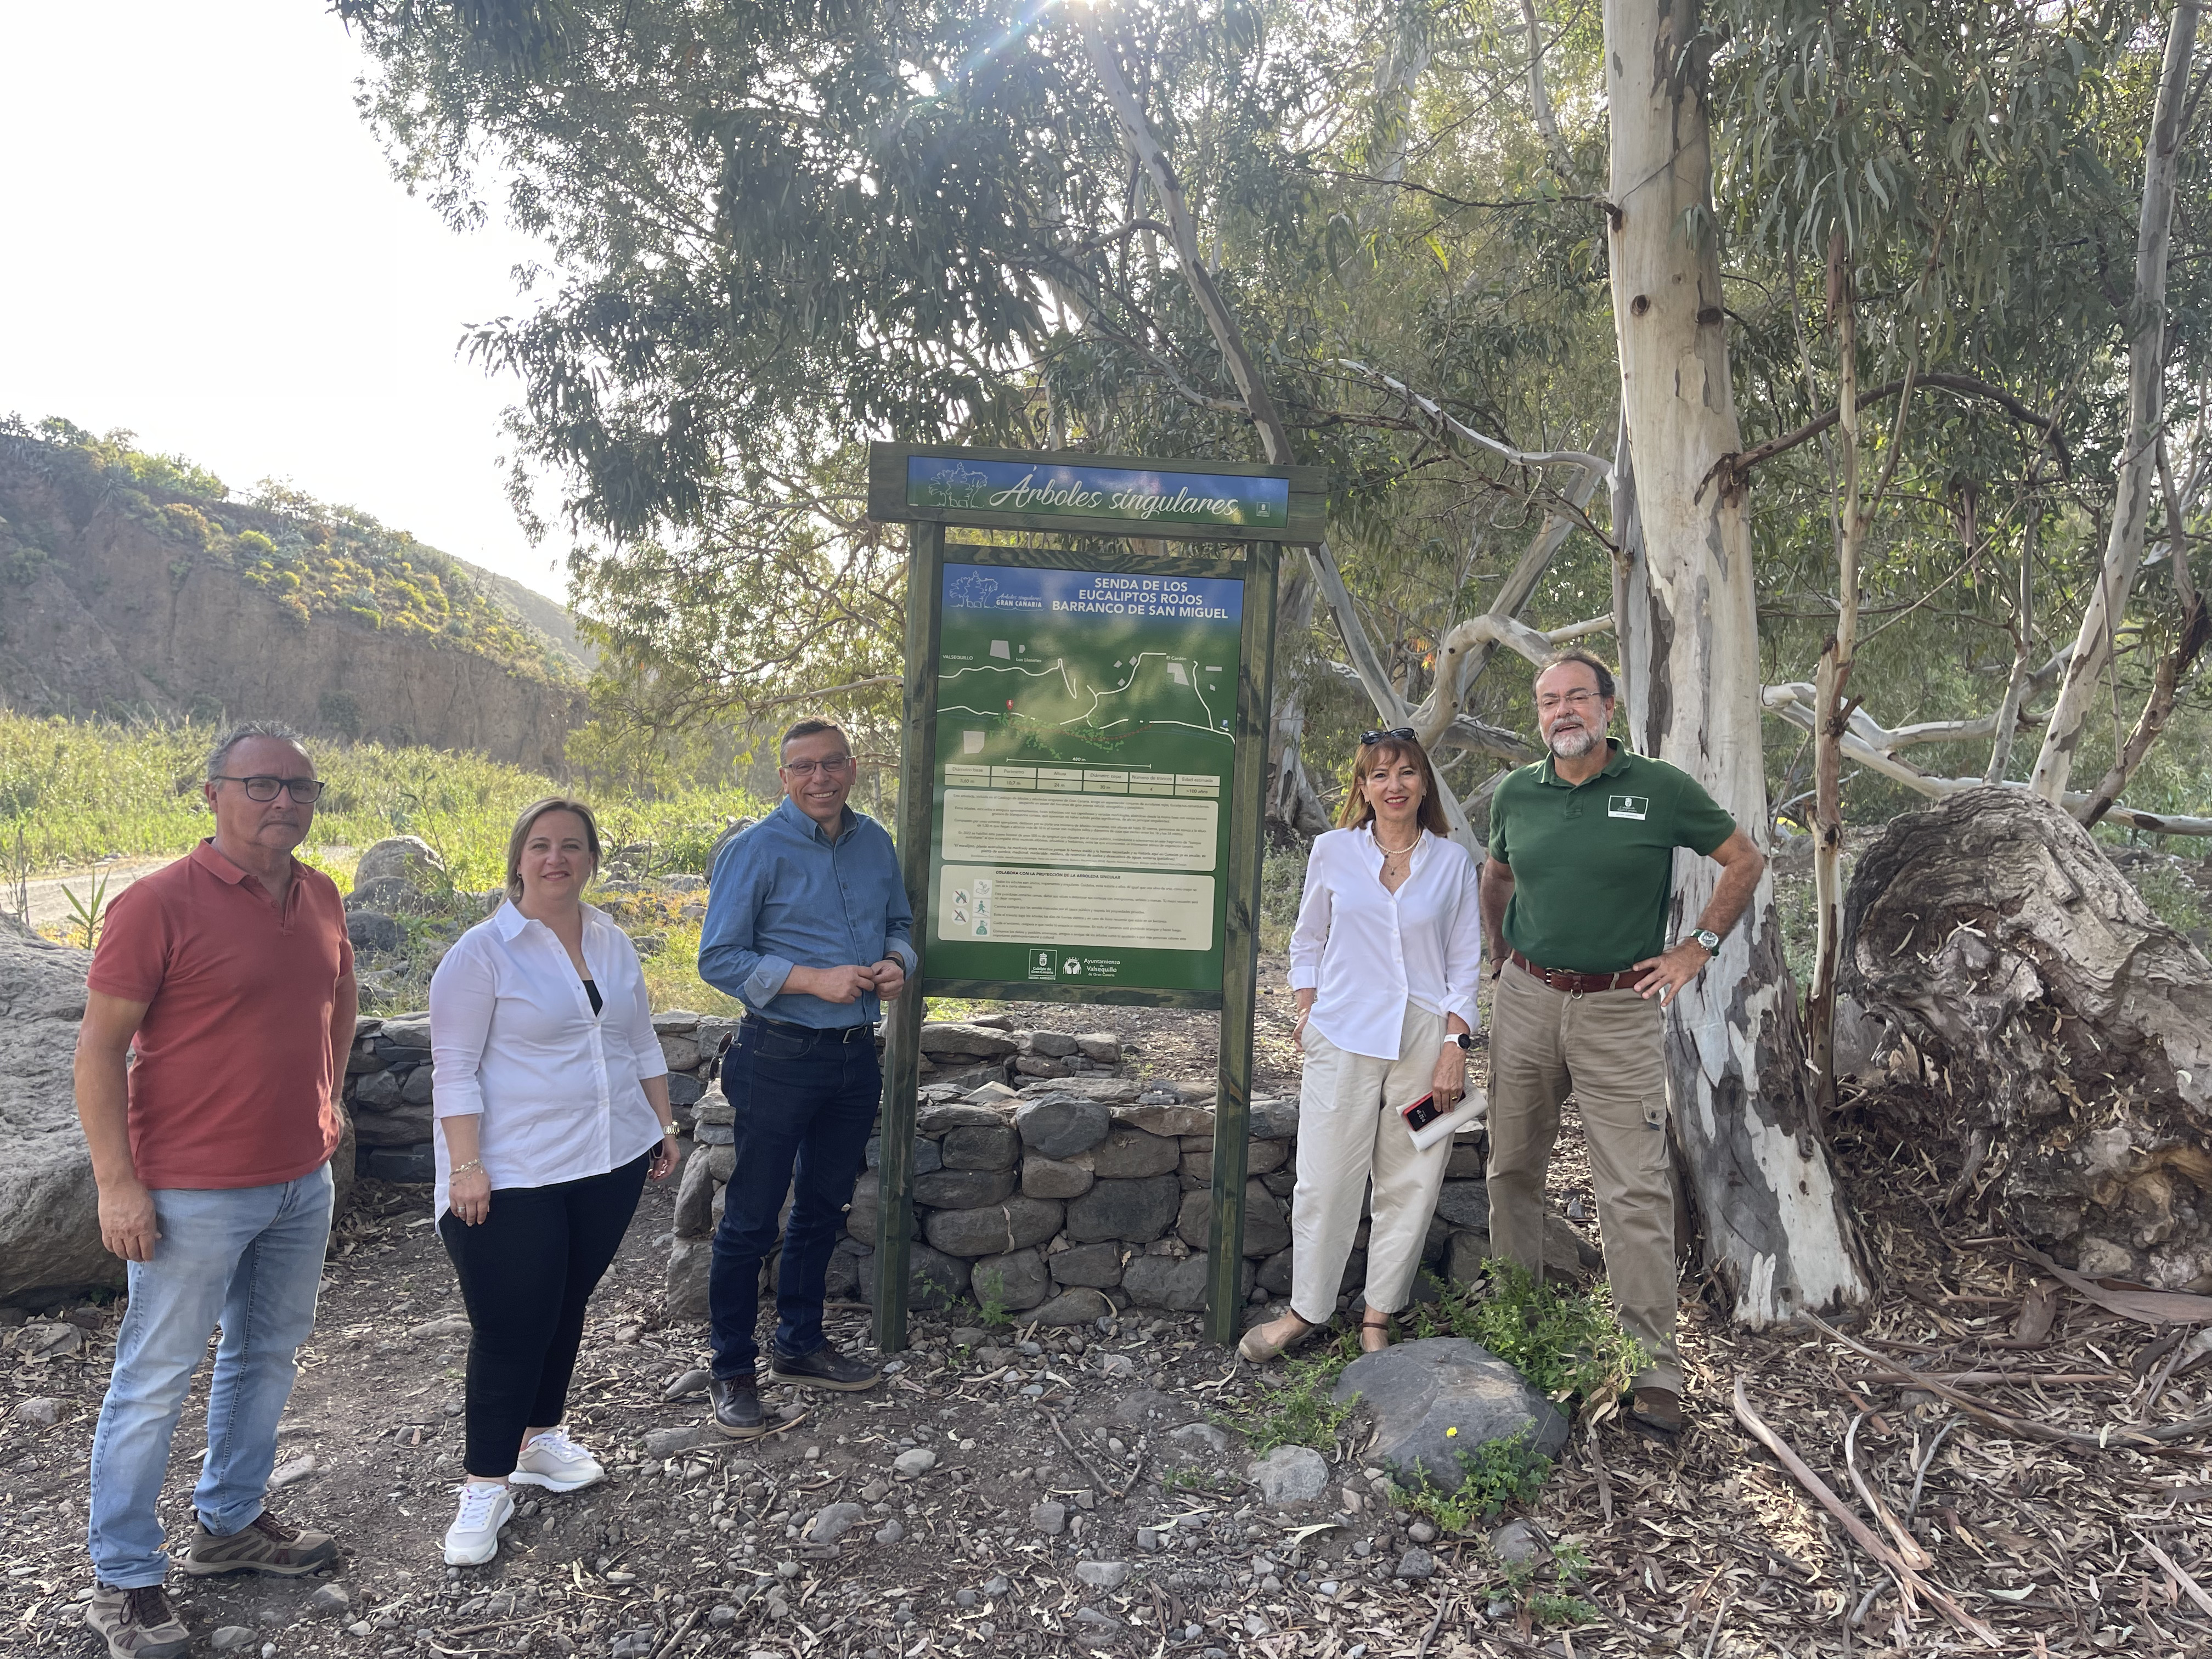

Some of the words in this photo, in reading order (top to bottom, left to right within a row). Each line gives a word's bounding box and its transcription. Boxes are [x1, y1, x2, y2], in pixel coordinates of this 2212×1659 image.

[989, 465, 1103, 508] Árboles
[1109, 486, 1238, 520] singulares
[1094, 578, 1138, 590] SENDA
[1143, 580, 1159, 591] DE
[1164, 581, 1188, 592] LOS
[1079, 589, 1156, 603] EUCALIPTOS
[1160, 594, 1203, 605] ROJOS
[1052, 600, 1124, 614] BARRANCO
[1128, 604, 1145, 615] DE
[1149, 605, 1175, 617] SAN
[1179, 607, 1228, 619] MIGUEL
